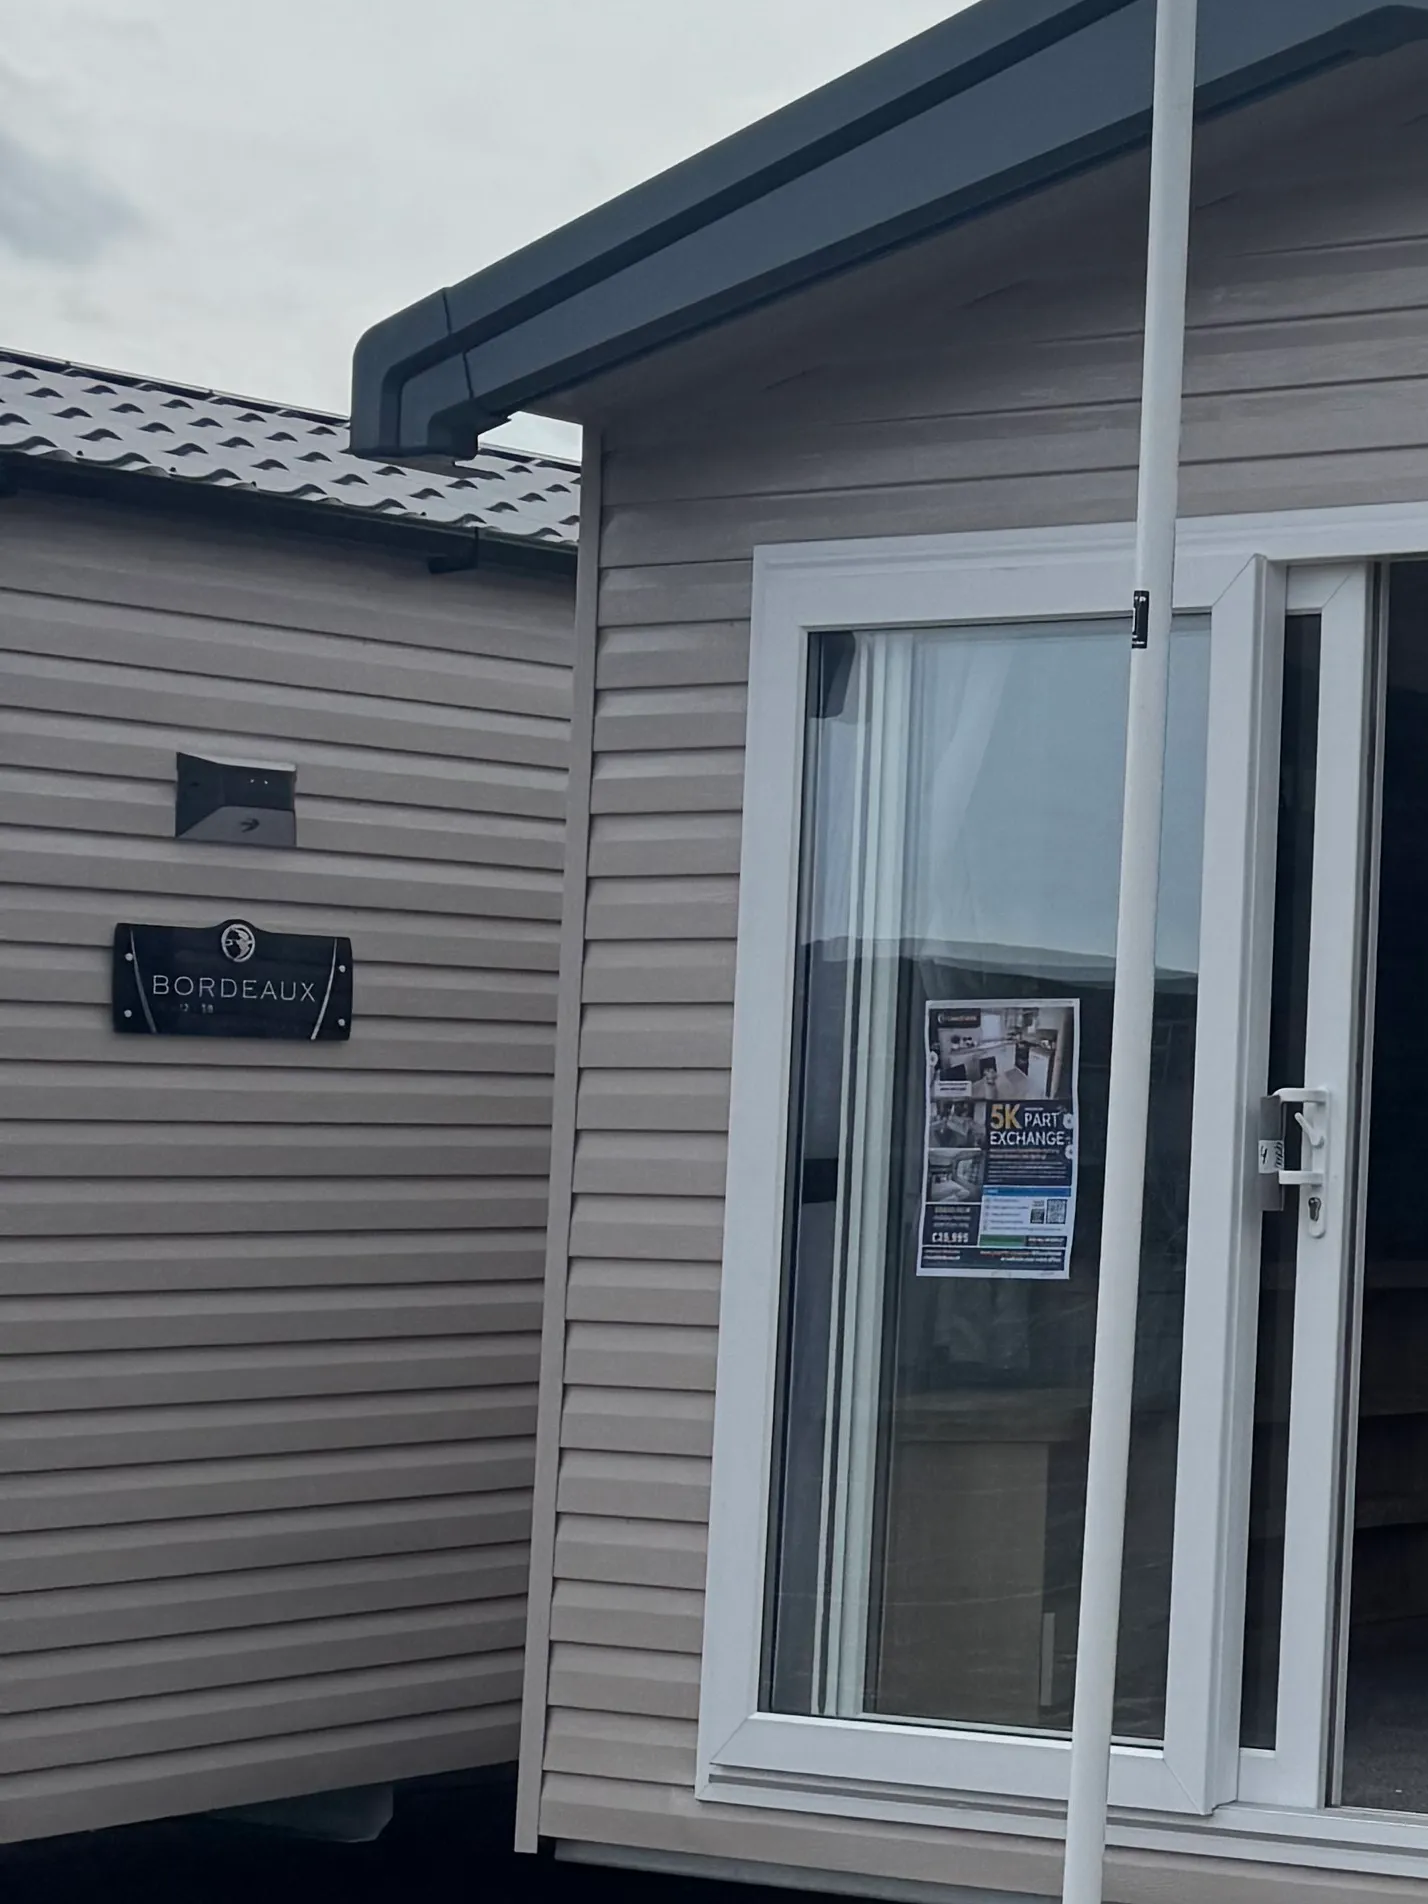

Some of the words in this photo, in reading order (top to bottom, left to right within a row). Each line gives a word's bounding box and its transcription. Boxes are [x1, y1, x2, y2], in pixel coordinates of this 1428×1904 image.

[152, 974, 316, 1003] BORDEAUX
[990, 1103, 1022, 1130] 5K
[1024, 1112, 1059, 1127] PART
[990, 1131, 1066, 1145] EXCHANGE
